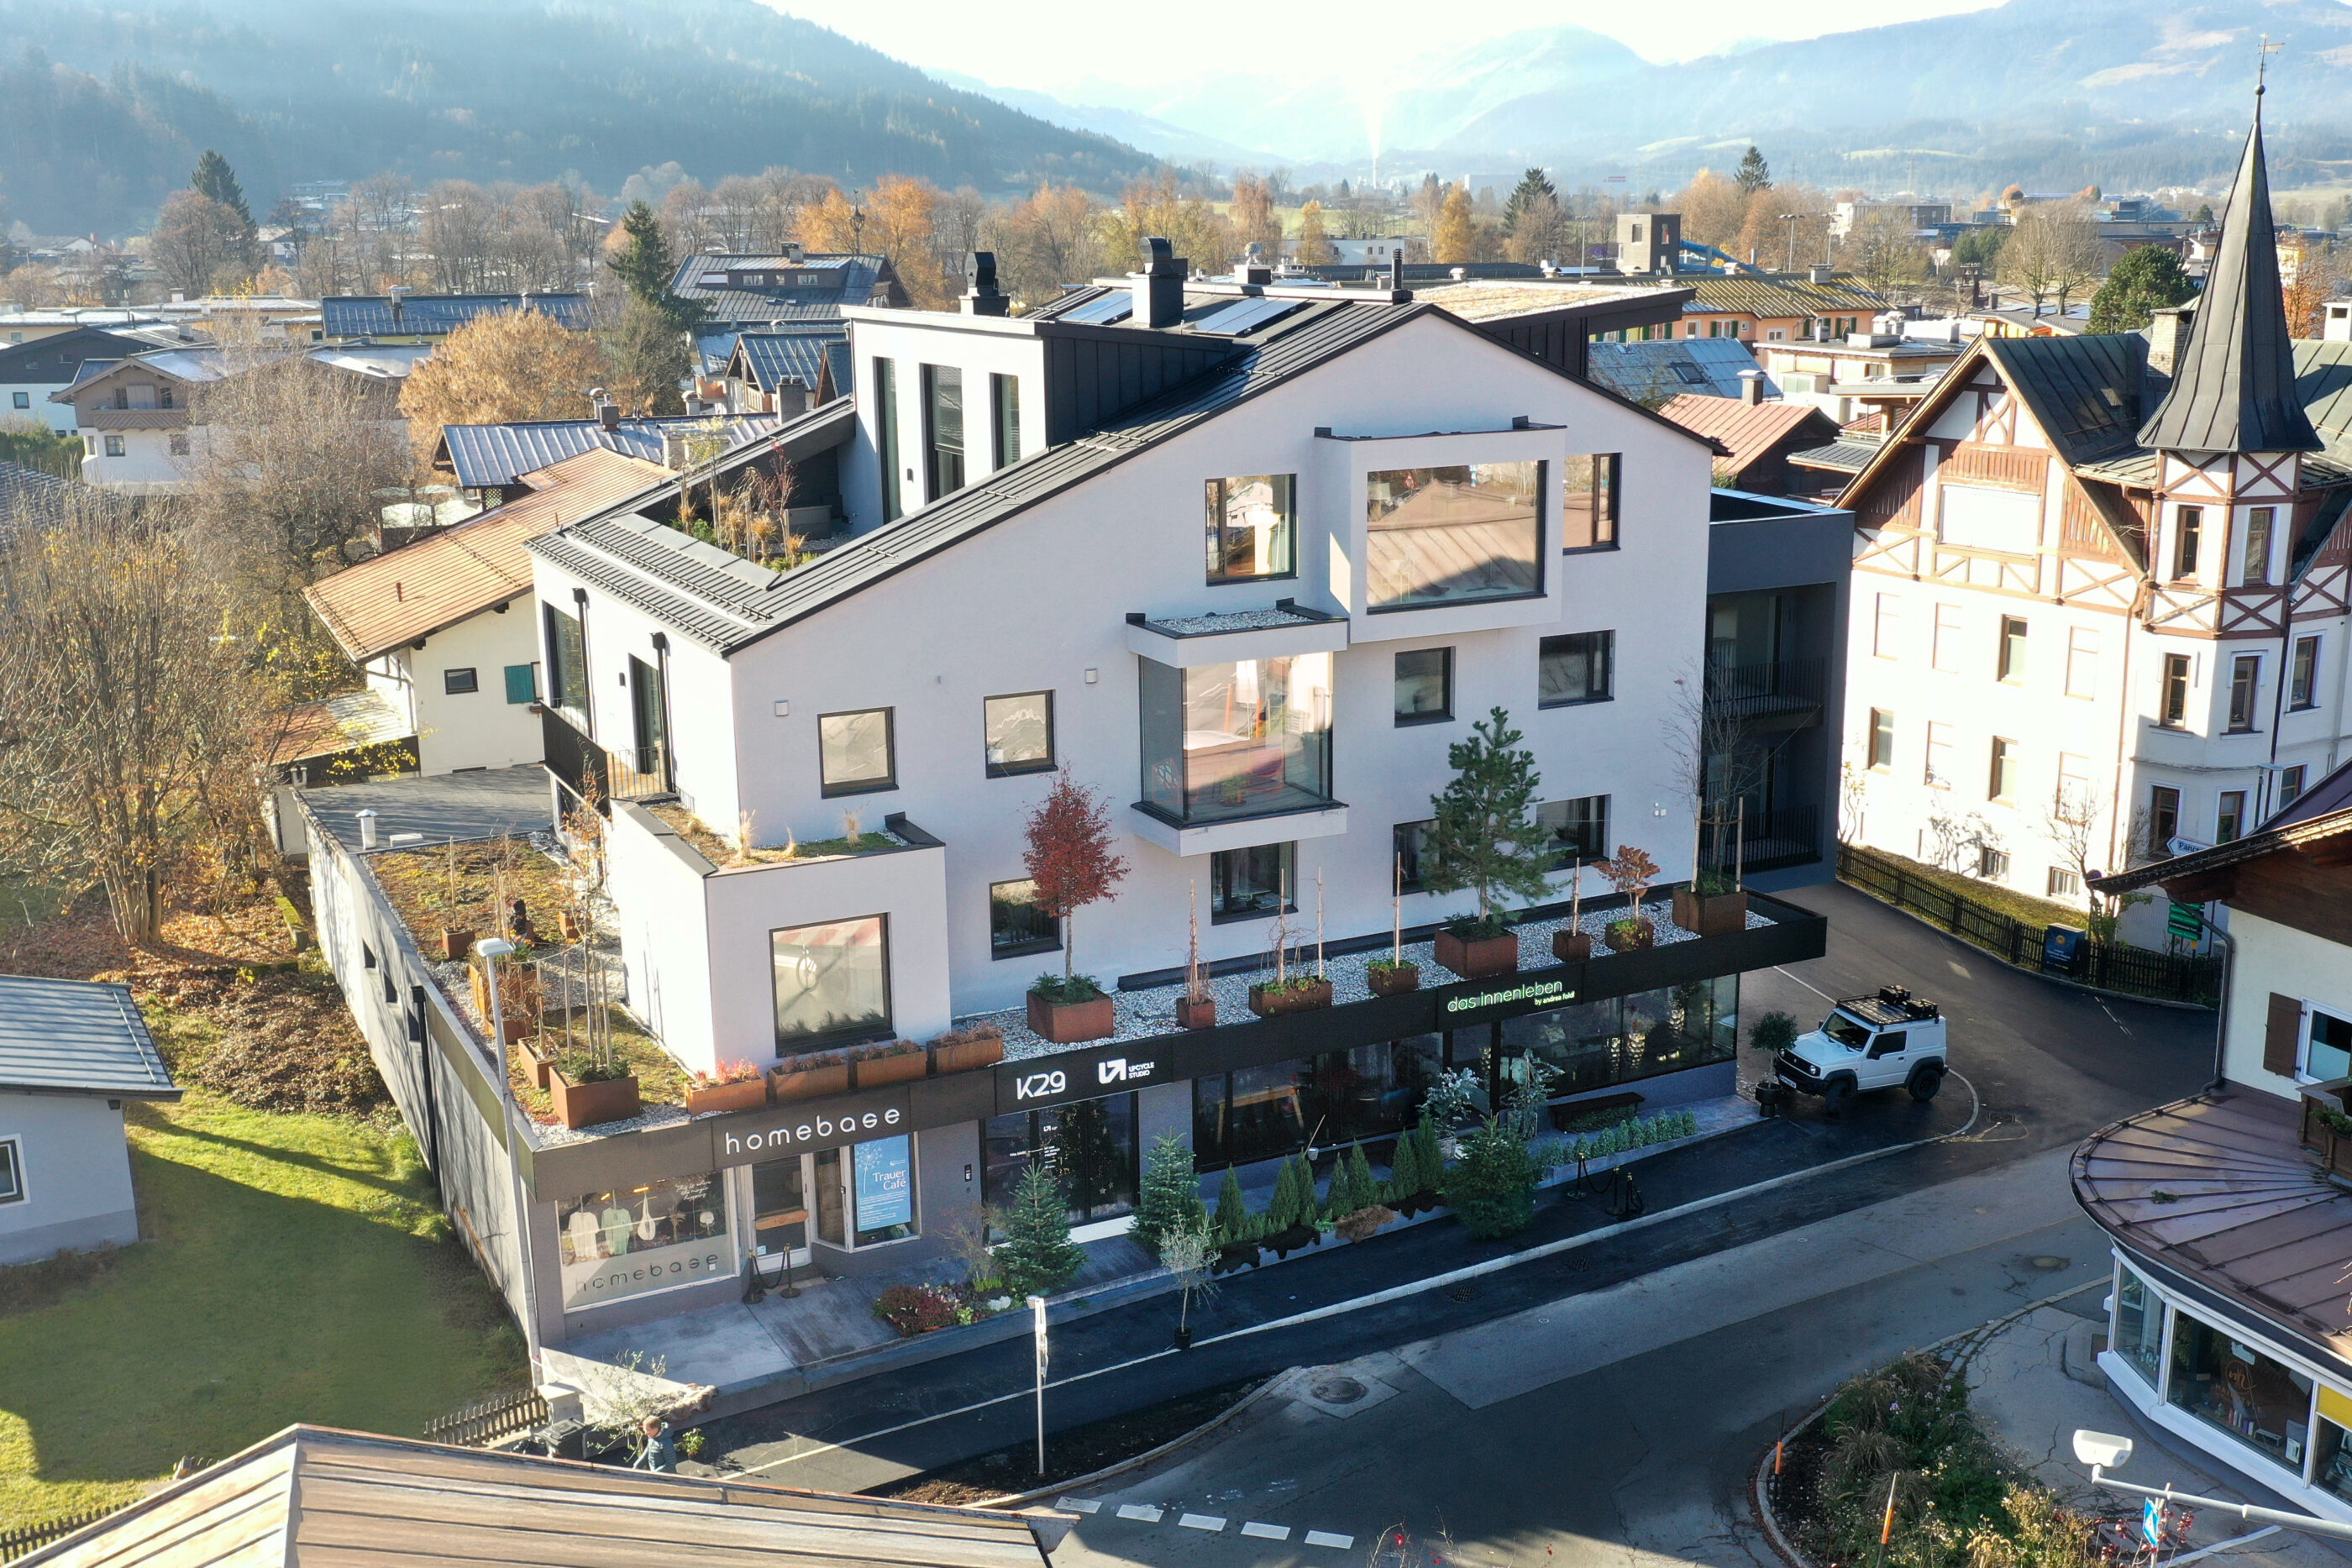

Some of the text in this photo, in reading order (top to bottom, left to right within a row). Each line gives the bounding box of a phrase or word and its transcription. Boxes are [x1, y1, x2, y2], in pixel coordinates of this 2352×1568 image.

[1447, 981, 1562, 1012] das innenleben
[1534, 998, 1542, 1006] by
[1542, 994, 1562, 1004] andrea
[1128, 1062, 1155, 1072] UPCYCLE
[1128, 1070, 1151, 1079] STUDIO
[1016, 1070, 1067, 1100] K29
[725, 1108, 900, 1155] homebase
[872, 1169, 906, 1183] Trauer
[883, 1177, 906, 1191] Café
[576, 1254, 719, 1293] homebase
